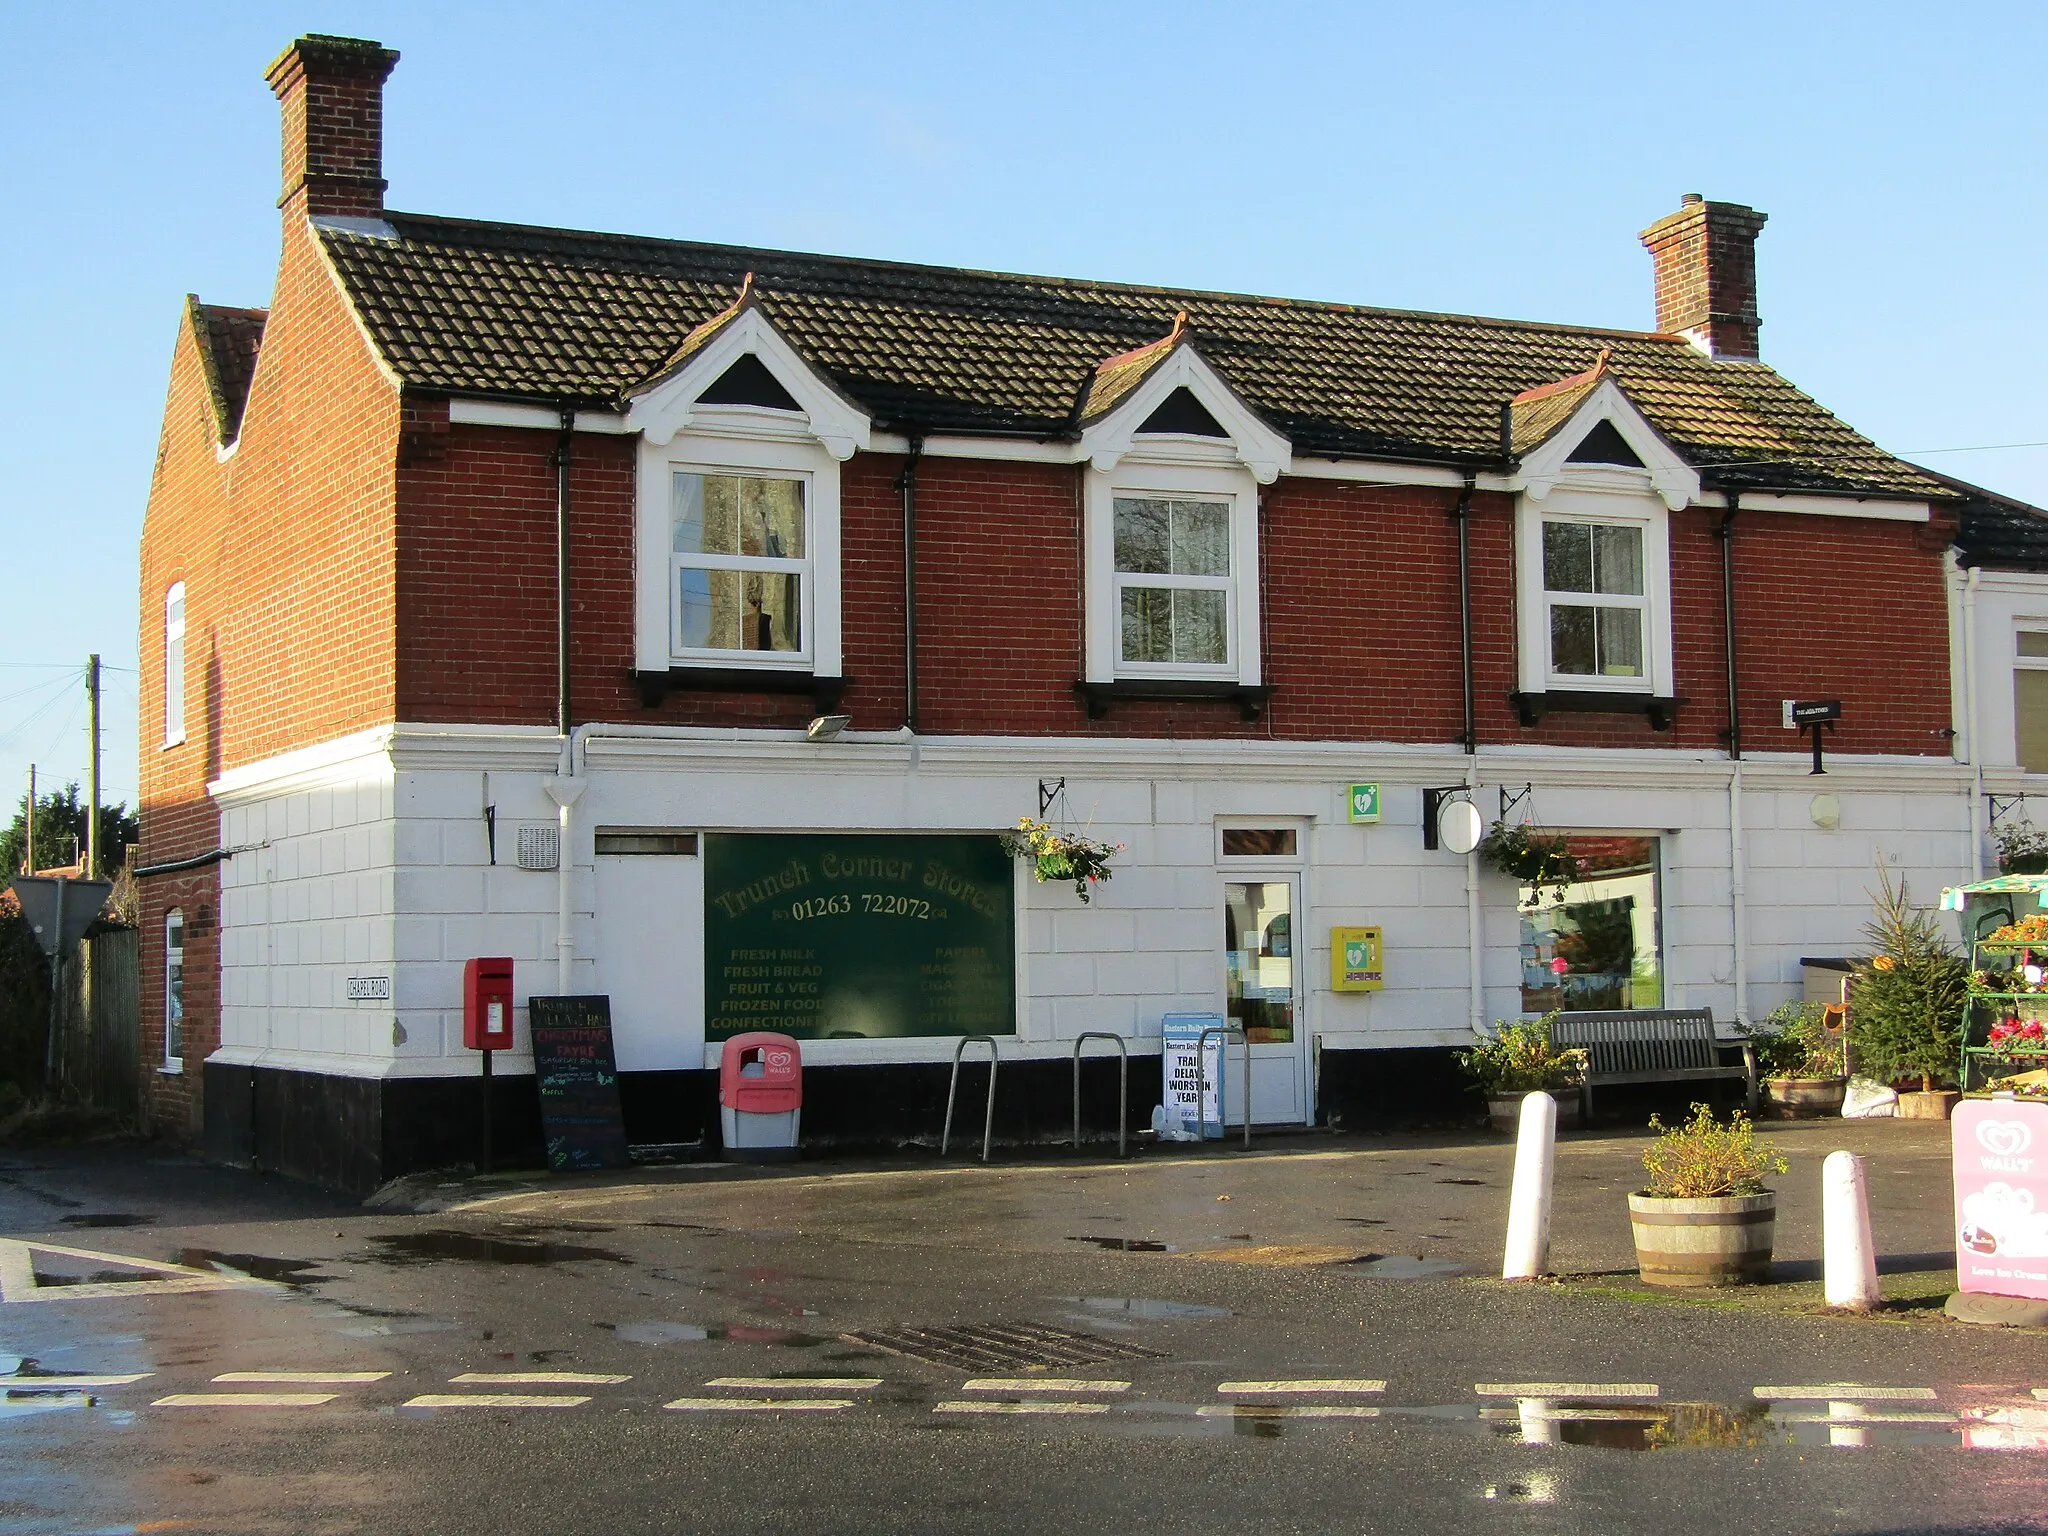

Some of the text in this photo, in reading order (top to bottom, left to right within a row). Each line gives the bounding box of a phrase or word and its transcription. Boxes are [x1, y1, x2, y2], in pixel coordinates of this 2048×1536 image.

[715, 852, 999, 921] Trunch Corner Stores
[791, 894, 931, 921] 01263 722072
[731, 948, 817, 960] FRESH MILK
[724, 965, 823, 978] FRESH BREAD
[350, 980, 387, 996] CHAPEL ROAD
[729, 982, 818, 994] FRUIT & VEG
[721, 1000, 780, 1012] FROZEN
[1164, 1024, 1187, 1032] Eastern
[1187, 1024, 1203, 1034] Daily
[537, 1029, 609, 1043] CHRISTMAS
[1177, 1056, 1198, 1066] TRAI
[1980, 1155, 2031, 1172] WALL'S
[1971, 1266, 1995, 1277] Love
